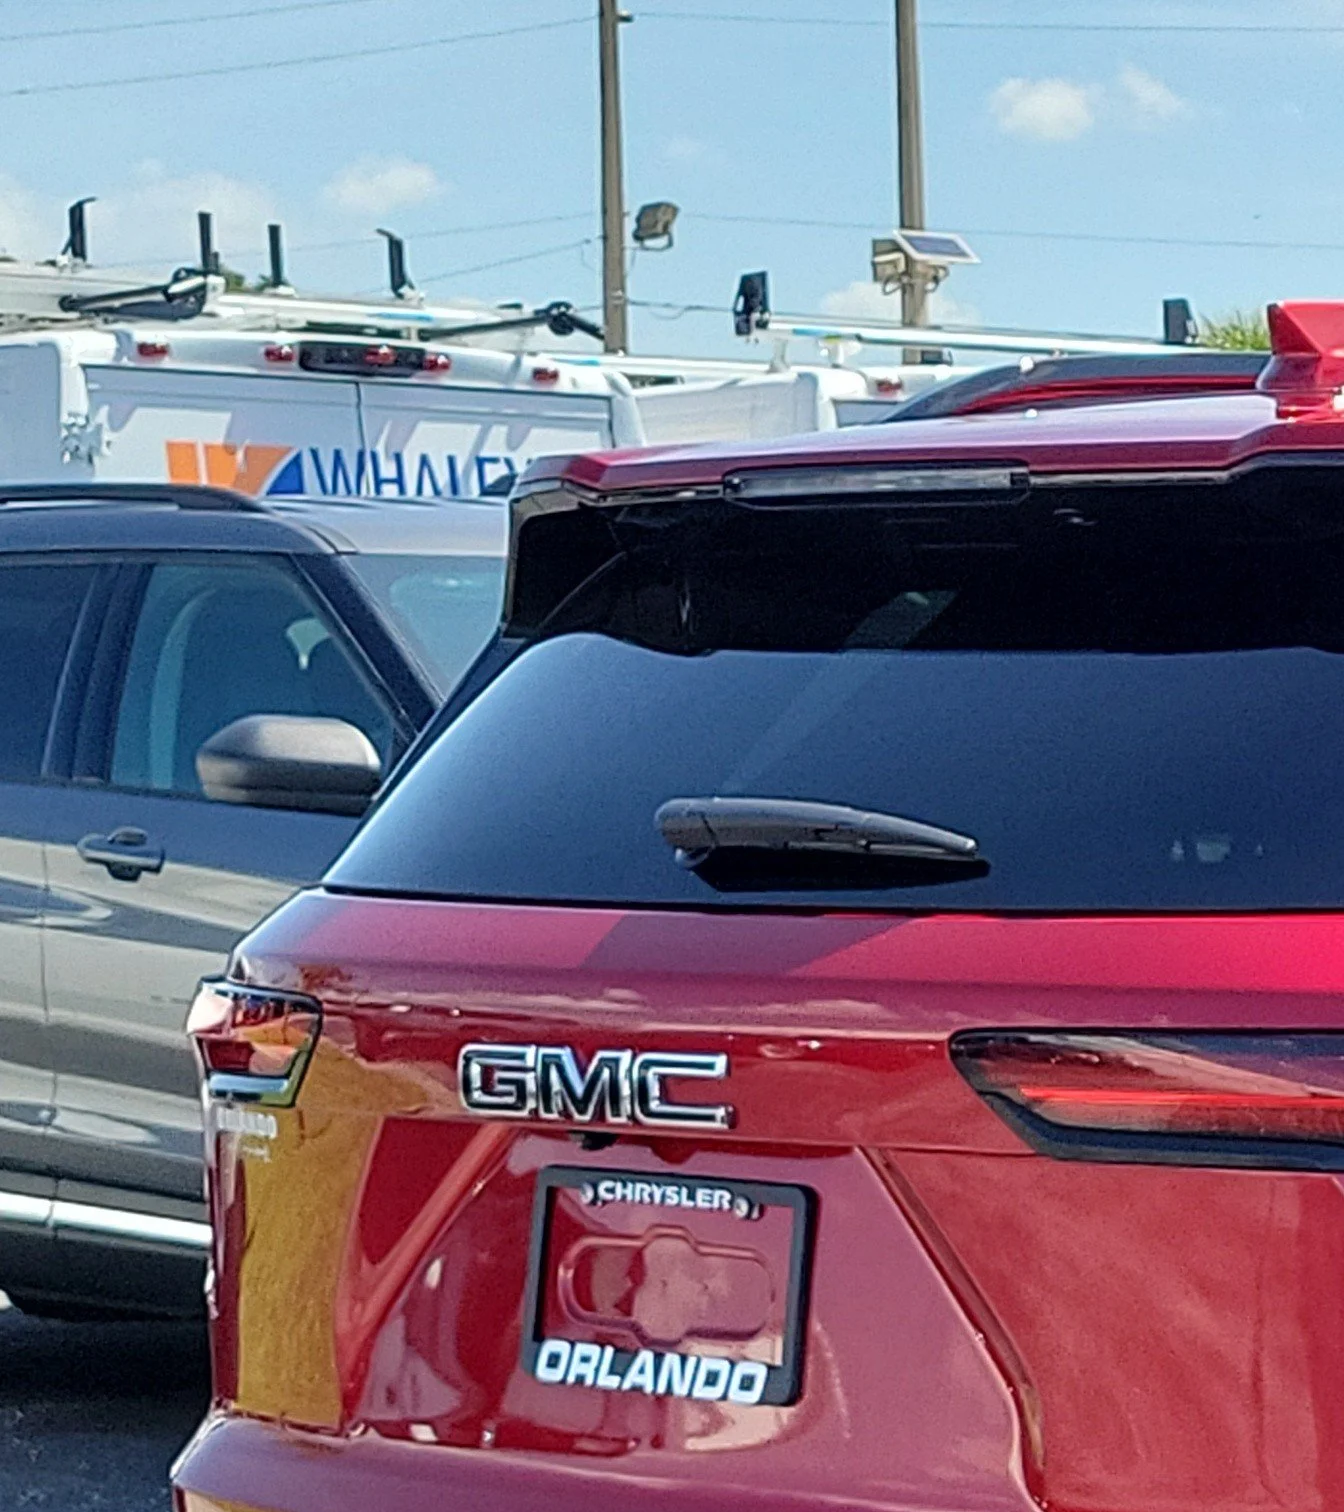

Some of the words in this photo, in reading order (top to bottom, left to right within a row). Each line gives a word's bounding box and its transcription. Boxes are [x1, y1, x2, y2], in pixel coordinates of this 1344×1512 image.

[457, 1042, 738, 1129] GMC
[597, 1179, 732, 1211] CHRYSLER
[535, 1338, 769, 1404] ORLANDO
